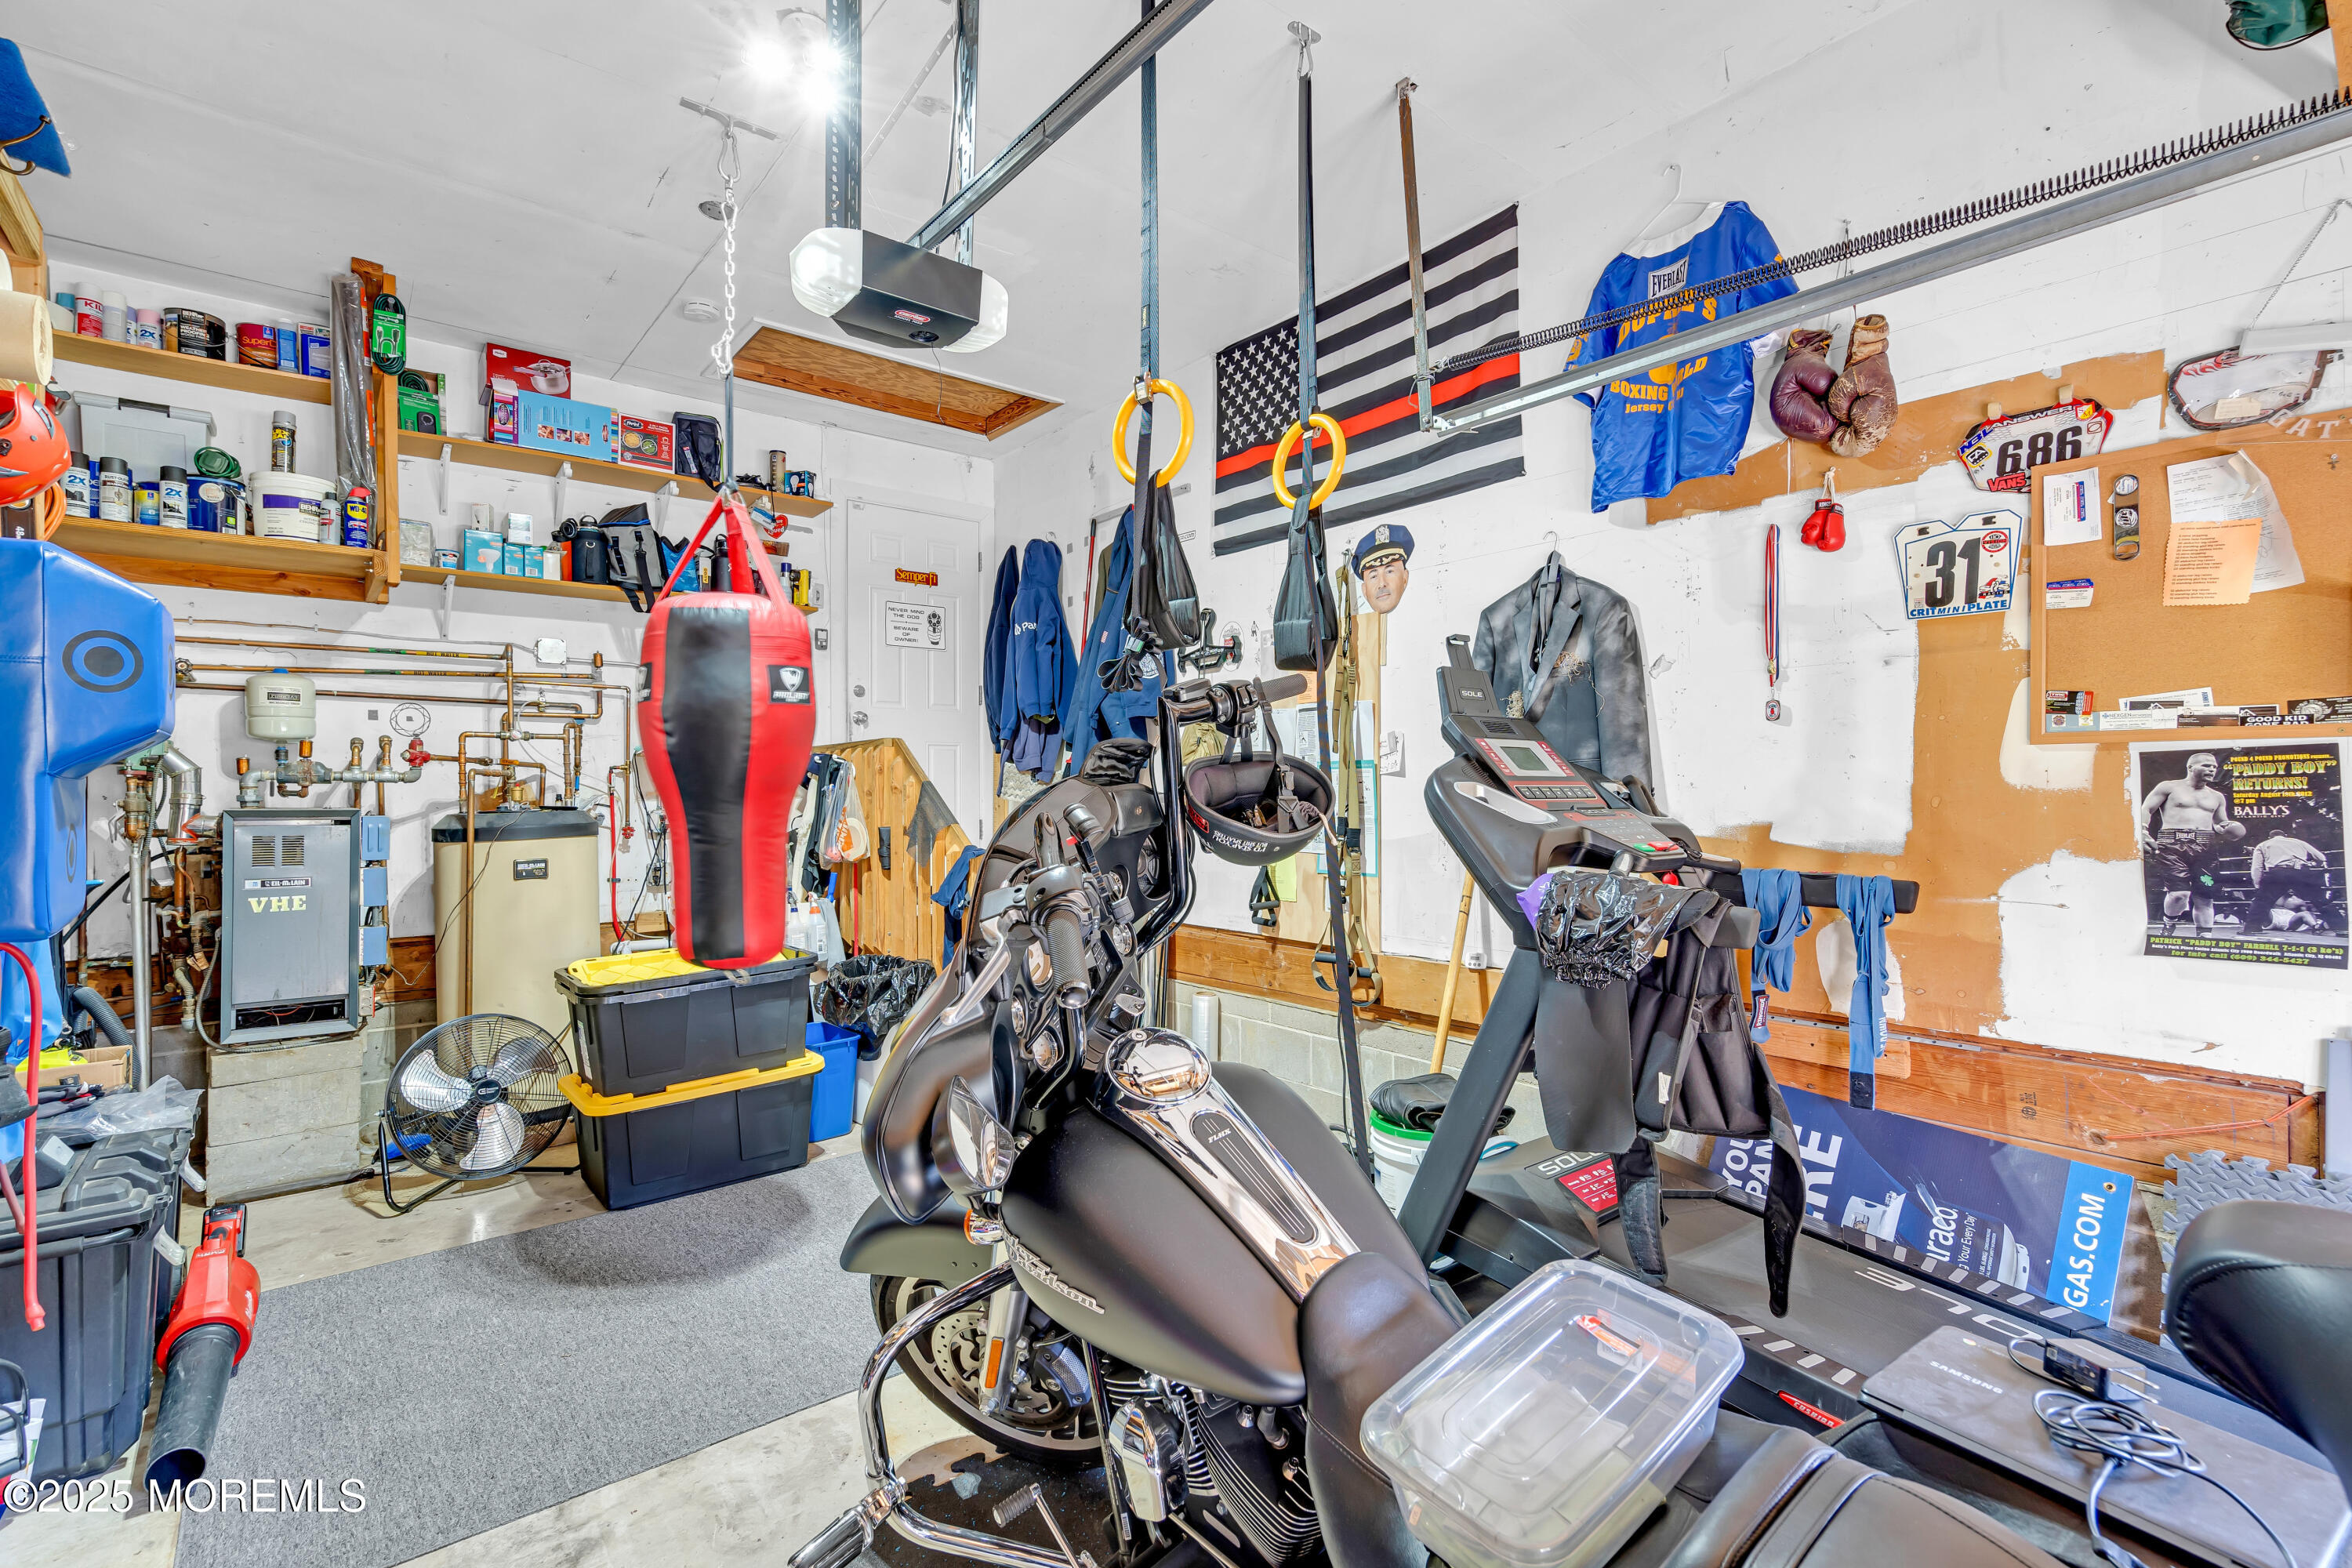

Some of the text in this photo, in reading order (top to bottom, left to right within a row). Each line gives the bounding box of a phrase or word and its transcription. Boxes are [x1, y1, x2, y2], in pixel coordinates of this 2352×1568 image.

[1651, 261, 1686, 297] EVERLAST
[84, 300, 103, 312] KIL
[140, 329, 156, 339] 2X
[1610, 379, 1668, 401] BOXING
[1625, 403, 1664, 414] Jersey
[1988, 405, 2073, 430] ANSWER
[2267, 409, 2352, 440] GAT
[1996, 425, 2082, 477] 686
[68, 474, 86, 486] 2X
[1987, 472, 2027, 493] VANS
[165, 487, 182, 498] 2X
[299, 503, 319, 512] BEHR
[896, 568, 937, 588] Semper Fi
[1926, 537, 1981, 608] 31
[1461, 689, 1484, 699] SOLE
[2233, 777, 2308, 790] RETURNS!
[2234, 805, 2290, 815] BALLY'S
[248, 895, 307, 913] VHE
[2259, 956, 2310, 964] 344-5427
[1207, 1128, 1232, 1143] FLHX
[1962, 1229, 1976, 1245] Every
[1958, 1247, 1970, 1262] Your
[2063, 1192, 2106, 1312] GAS.COM
[1854, 1266, 2044, 1340] OLE
[1928, 1360, 2004, 1395] SAMSUNG
